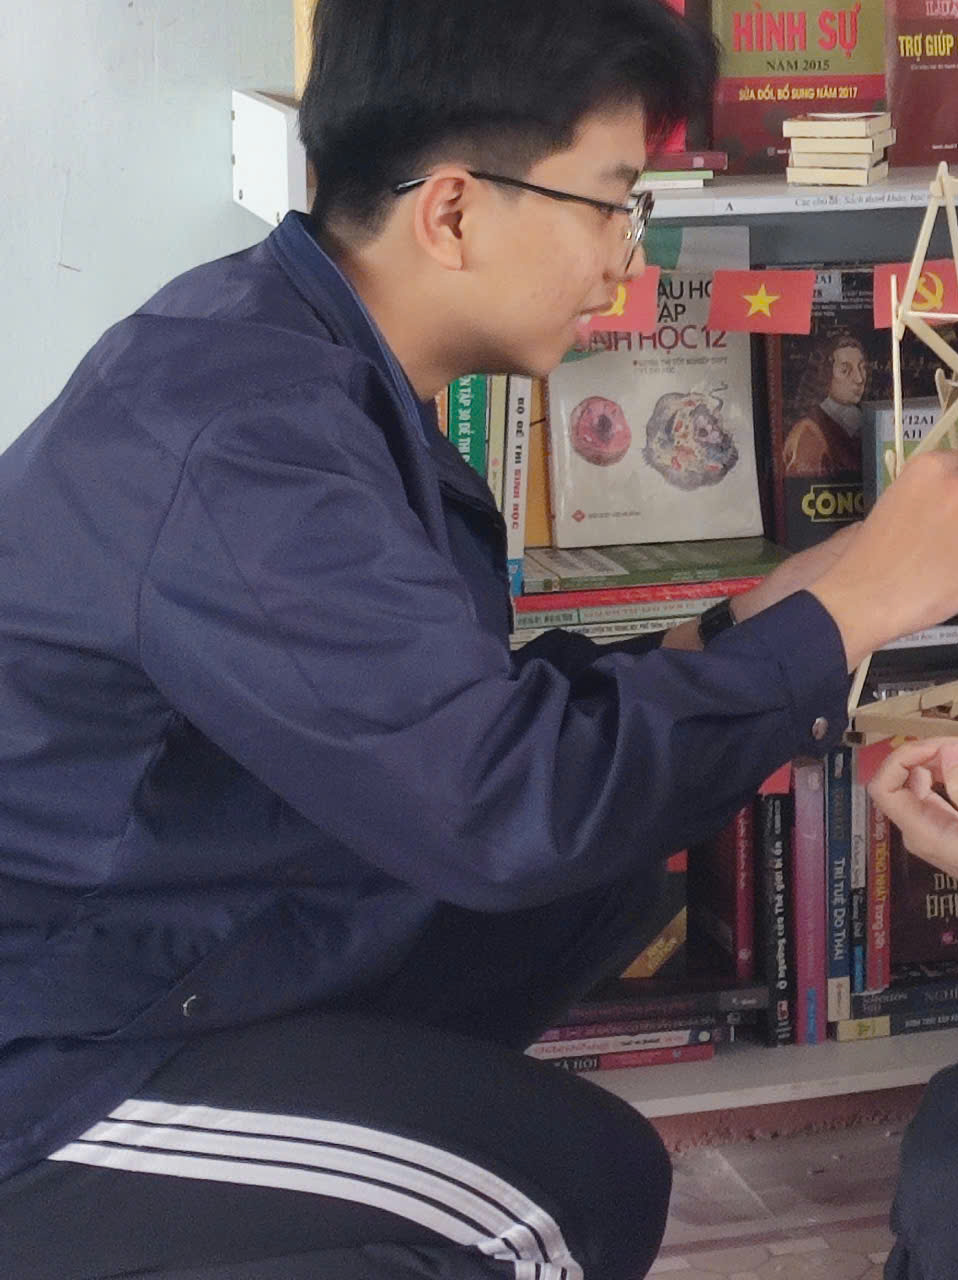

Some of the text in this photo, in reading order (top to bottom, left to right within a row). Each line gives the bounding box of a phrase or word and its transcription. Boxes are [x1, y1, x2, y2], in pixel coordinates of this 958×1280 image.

[732, 0, 862, 59] HÌNH SỰ
[898, 31, 923, 62] TRỢ
[925, 29, 954, 56] GIÚP
[803, 59, 830, 71] 2015
[838, 86, 859, 99] 2017
[514, 445, 523, 465] THI
[833, 910, 845, 929] DO
